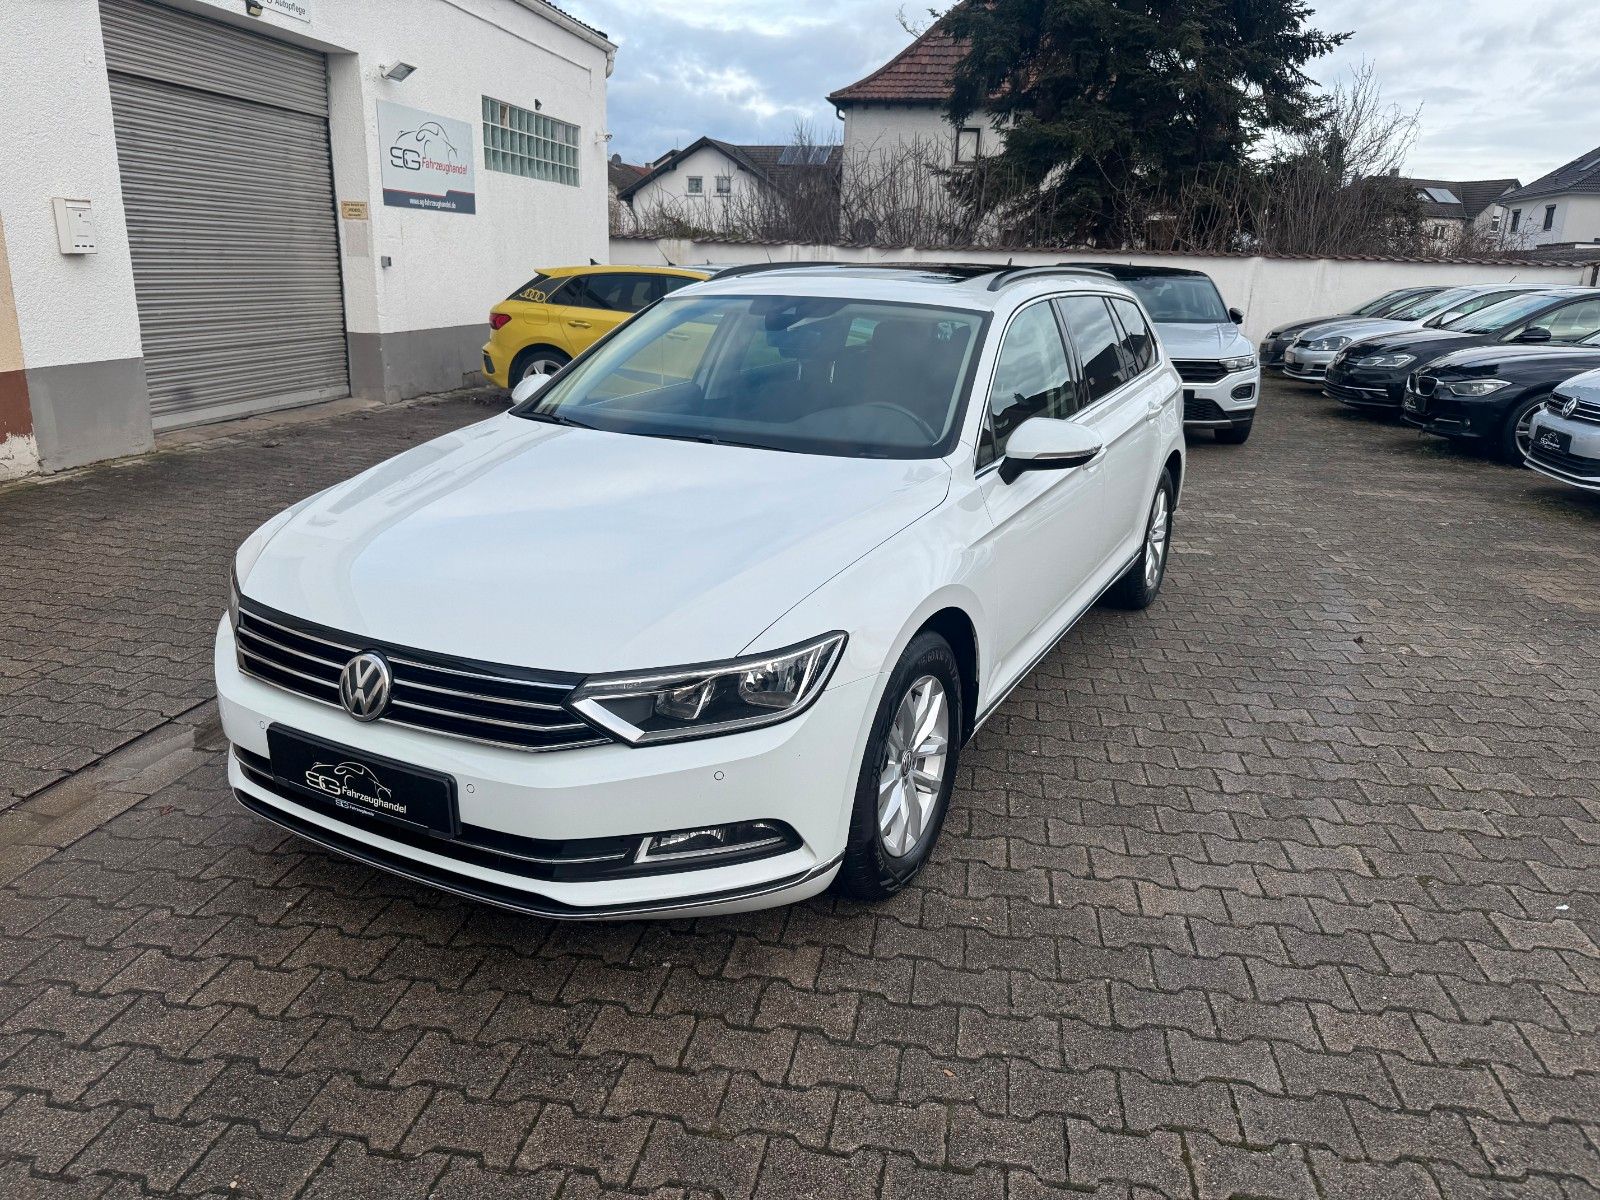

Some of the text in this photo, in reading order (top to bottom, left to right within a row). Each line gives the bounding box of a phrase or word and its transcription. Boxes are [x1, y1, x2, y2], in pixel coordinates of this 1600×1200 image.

[275, 0, 306, 15] Autopflege
[390, 146, 468, 175] SG Fahrzeughandel
[305, 770, 407, 814] SG Fahrzeughandel
